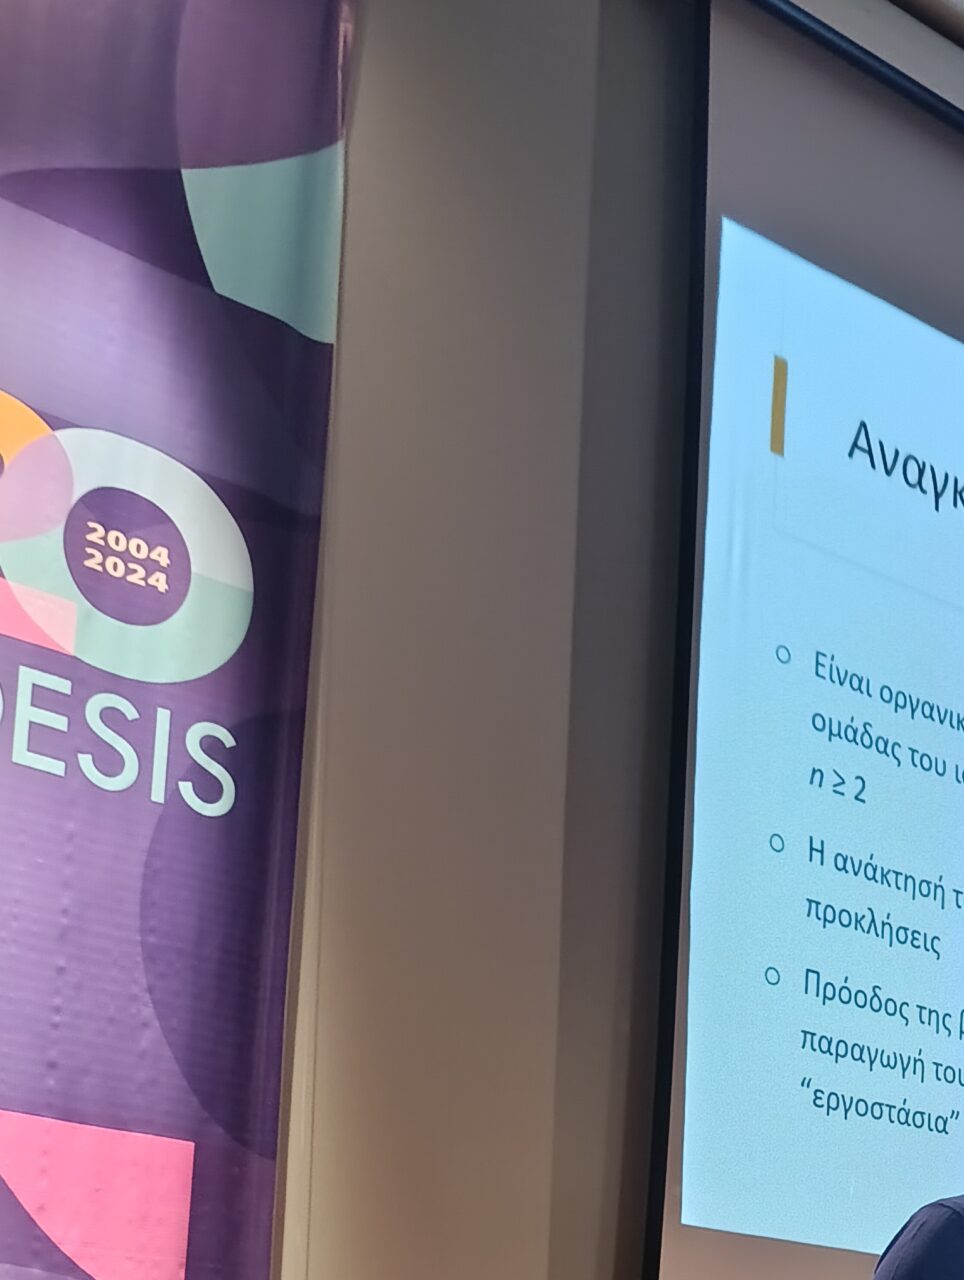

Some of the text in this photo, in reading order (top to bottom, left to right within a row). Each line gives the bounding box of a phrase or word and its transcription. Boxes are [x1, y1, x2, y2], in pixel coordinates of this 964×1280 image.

[83, 547, 169, 593] 2024
[85, 521, 171, 567] 2004
[814, 651, 873, 698] Είναι
[0, 665, 237, 817] ESIS
[811, 711, 901, 768] ομάδας
[908, 744, 947, 778] του
[809, 765, 825, 788] n
[853, 775, 867, 804] 2
[808, 836, 825, 865] Η
[833, 851, 946, 909] ανάκτησή
[805, 896, 942, 959] προκλήσεις
[803, 969, 910, 1020] Πρόοδος
[915, 1004, 952, 1038] της
[801, 1028, 926, 1084] παραγωγή
